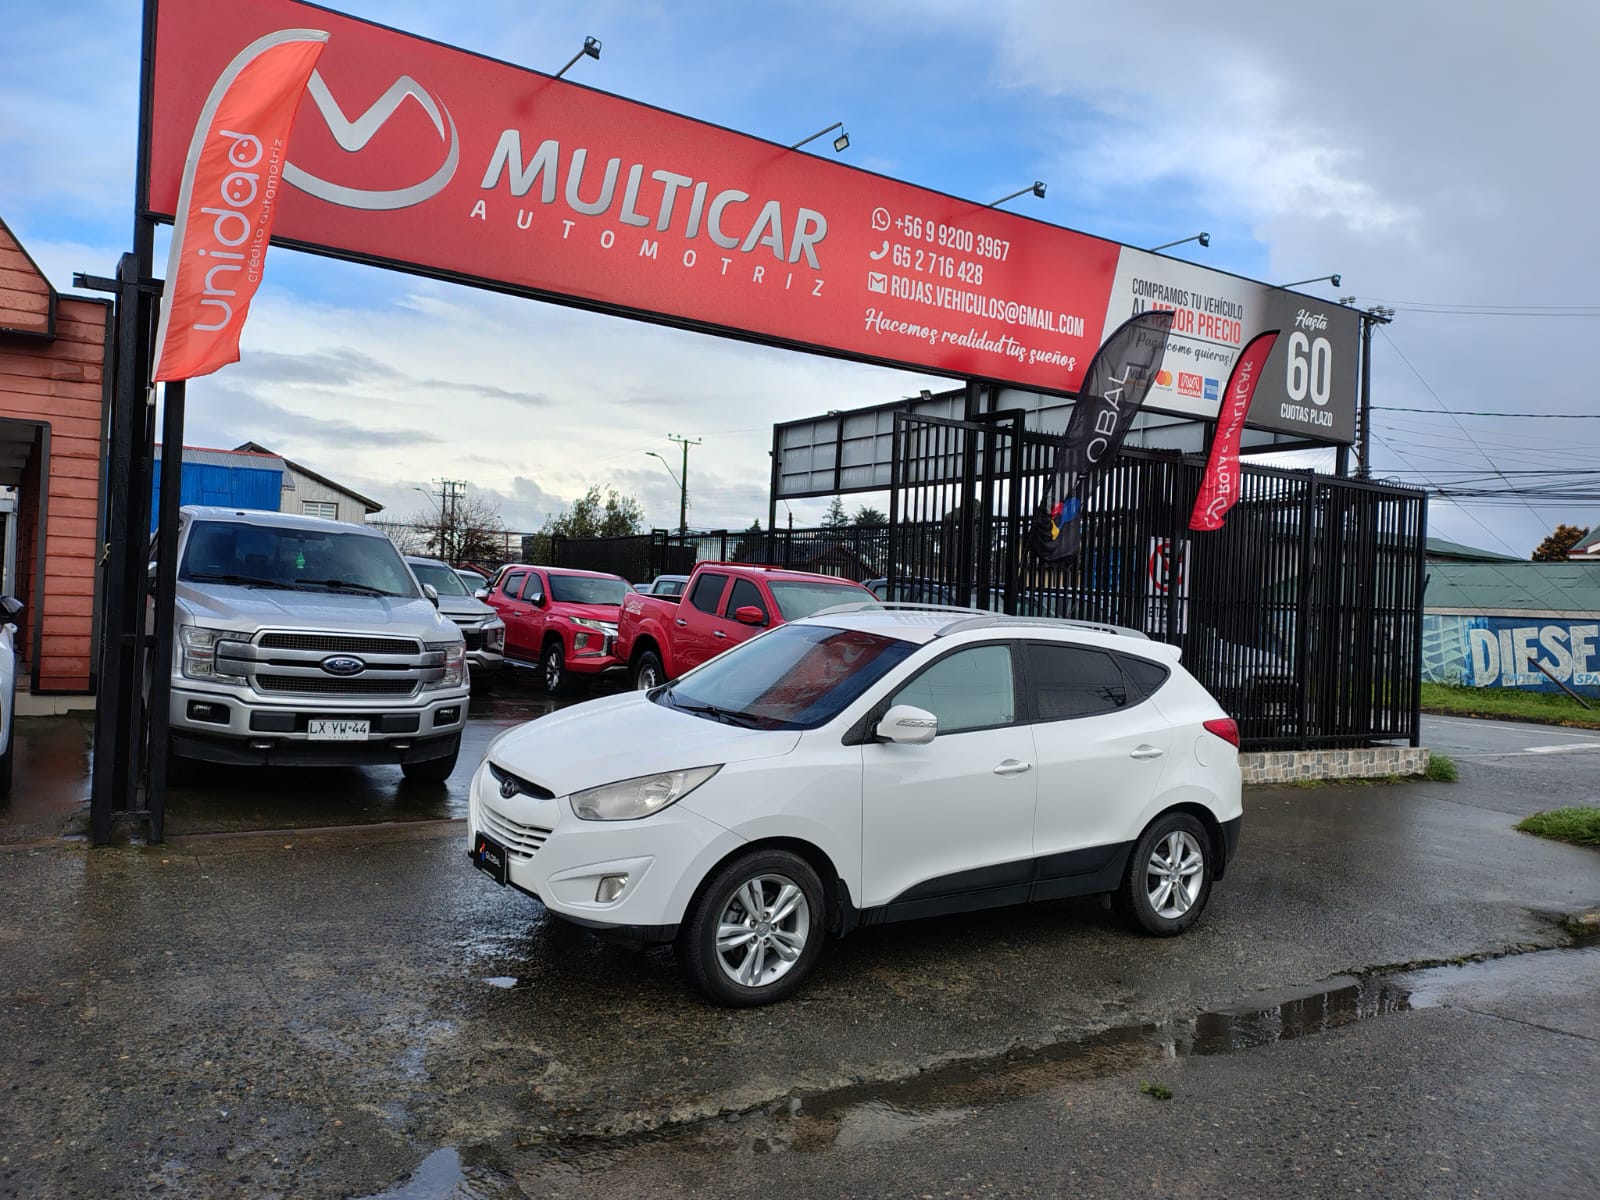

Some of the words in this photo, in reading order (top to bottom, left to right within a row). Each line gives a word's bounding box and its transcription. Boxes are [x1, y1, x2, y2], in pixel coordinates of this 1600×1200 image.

[248, 228, 264, 282] crédito
[260, 138, 282, 225] automotriz
[481, 129, 828, 270] MULTICAR
[193, 129, 263, 331] unidad
[470, 200, 825, 297] AUTOMOTRIZ
[895, 214, 922, 239] +56
[926, 220, 935, 242] 9
[938, 223, 973, 252] 9200
[976, 234, 1010, 261] 3967
[892, 243, 911, 268] 65
[915, 249, 924, 271] 2
[928, 252, 954, 279] 716
[957, 260, 983, 286] 428
[891, 274, 1085, 338] ROJAS.VEHICULOS@GMAIL.COM
[1132, 278, 1189, 306] COMPRAMOS
[1191, 293, 1202, 310] TU
[1204, 297, 1243, 320] VEHÍCULO
[1151, 302, 1195, 334] MEJOR
[1198, 312, 1241, 344] PRECIO
[1294, 308, 1328, 331] Hasta
[864, 307, 940, 345] Hacemos
[941, 327, 1006, 354] realidad
[1003, 334, 1027, 363] tus
[1029, 350, 1077, 372] sueños
[1166, 342, 1193, 356] como
[1195, 347, 1235, 368] quieras!
[1286, 331, 1332, 406] 60
[1280, 402, 1309, 423] CUOTAS
[1310, 410, 1333, 427] PLAZO
